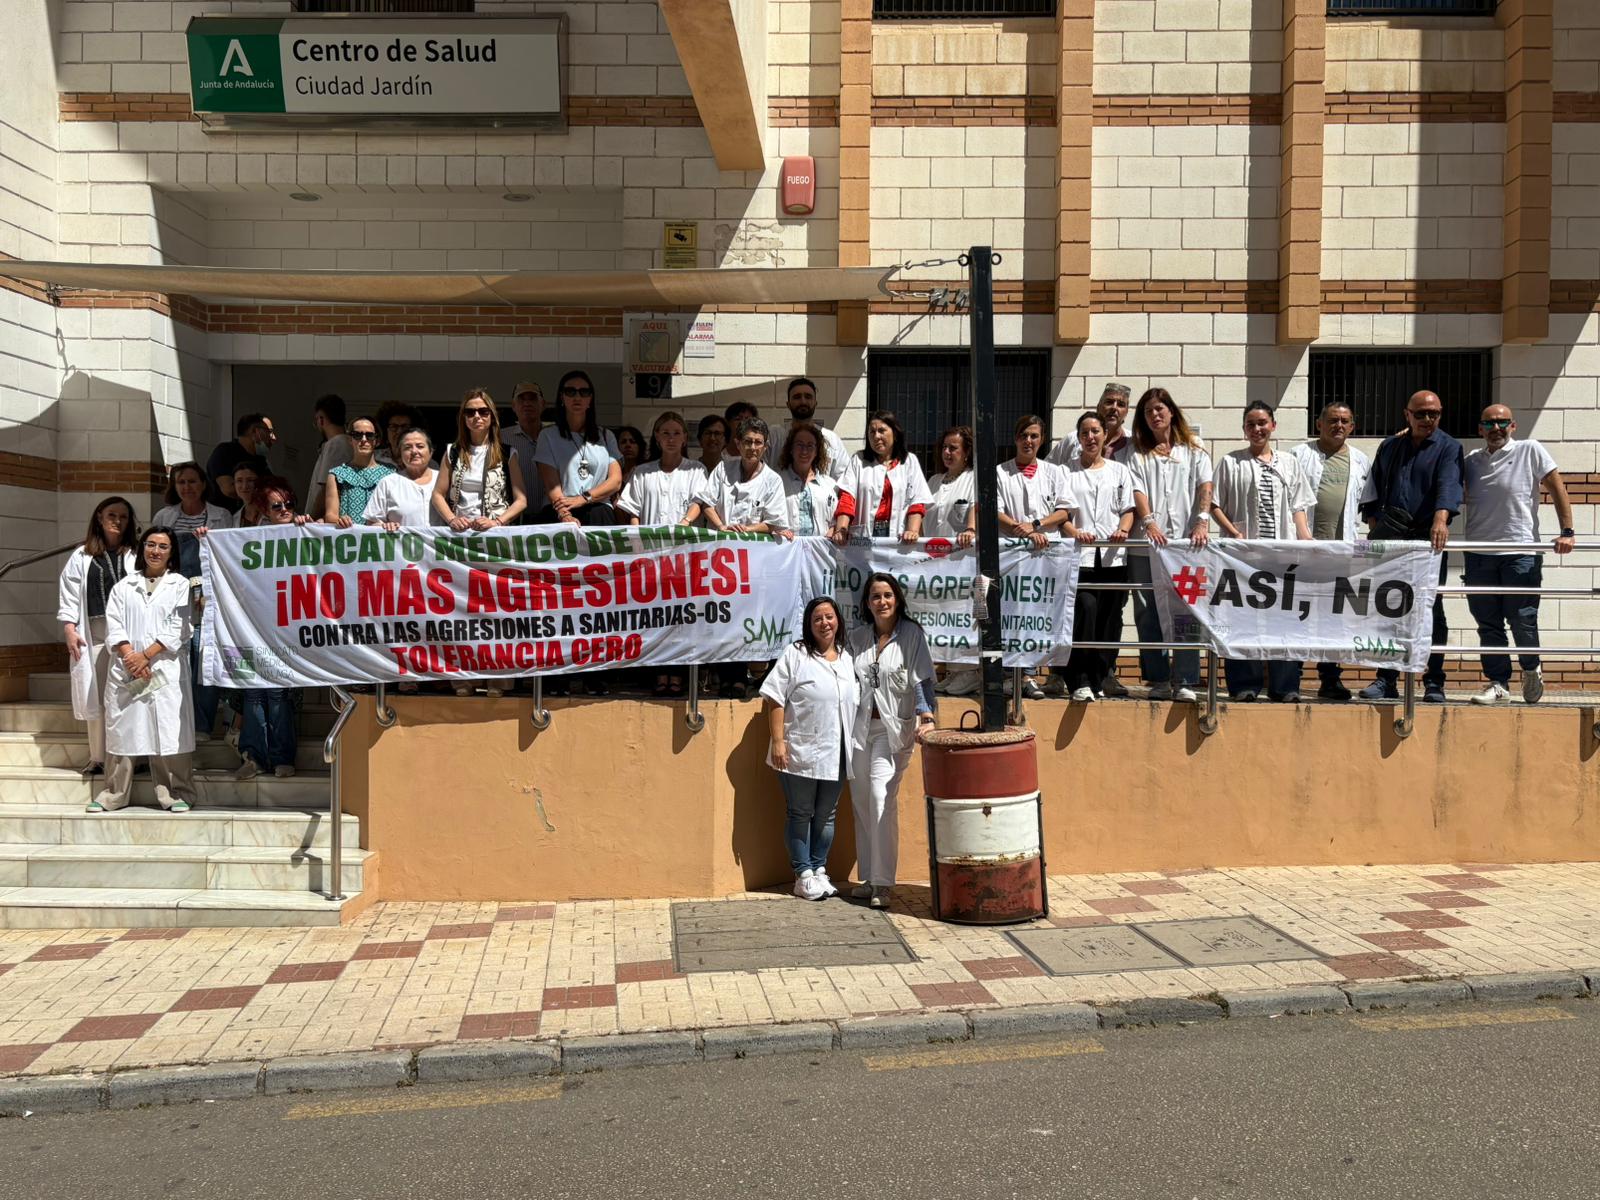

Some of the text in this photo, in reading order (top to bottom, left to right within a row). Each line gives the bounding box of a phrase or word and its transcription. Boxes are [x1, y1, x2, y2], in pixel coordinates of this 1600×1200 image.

[292, 38, 497, 63] Centro de Salud
[200, 79, 275, 89] Junta de Andalucía
[294, 75, 433, 96] Ciudad Jardín
[787, 175, 810, 185] FUEGO
[632, 364, 678, 372] VACUNAS
[241, 532, 425, 571] SINDICATO
[433, 530, 578, 563] MÉDICO
[585, 528, 634, 558] DE
[276, 547, 751, 627] ¡NO MÁS AGRESIONES!
[823, 568, 861, 595] ¡¡NO
[1172, 564, 1414, 621] #ASÍ, NO
[299, 600, 731, 648] CONTRA LAS AGRESIONES A SANITARIAS-OS
[1001, 614, 1053, 633] NITARIOS
[391, 633, 643, 675] TOLERANCIA CERO
[1000, 638, 1052, 653] ERO!!
